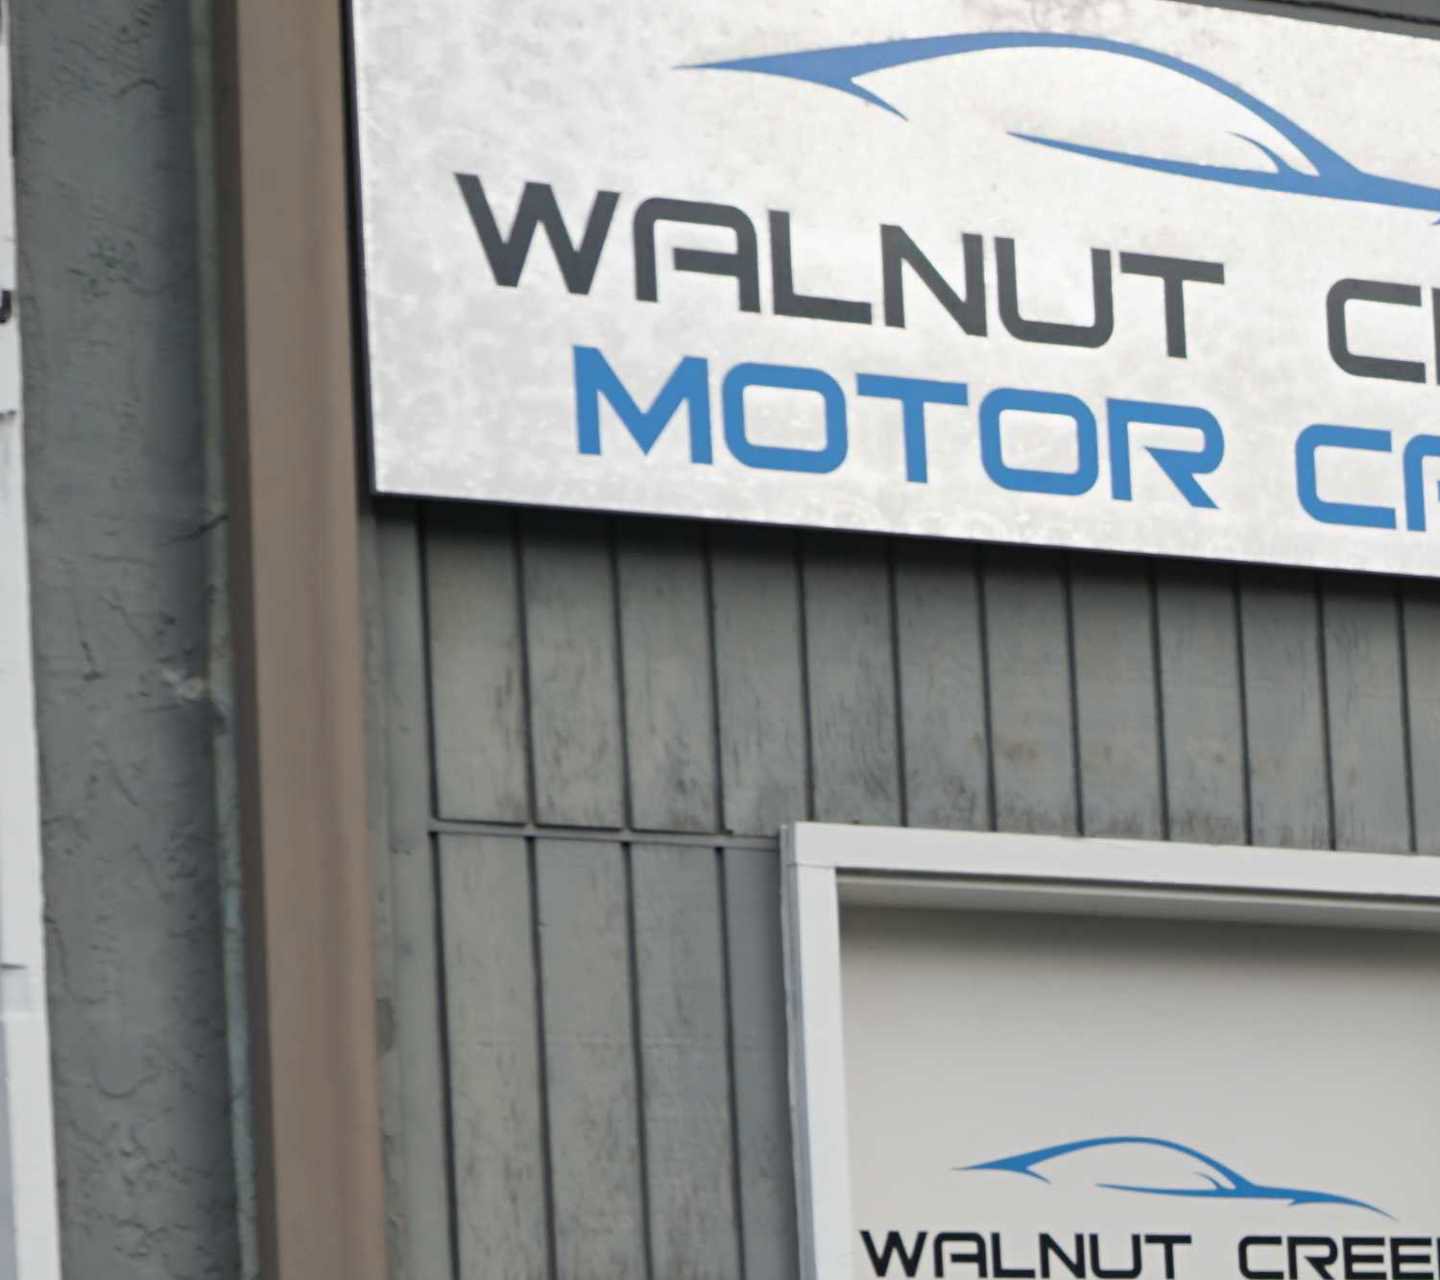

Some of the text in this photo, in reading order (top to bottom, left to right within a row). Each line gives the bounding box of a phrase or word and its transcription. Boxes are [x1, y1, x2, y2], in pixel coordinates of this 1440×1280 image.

[454, 172, 1226, 360] WALNUT
[573, 344, 1226, 509] MOTOR
[859, 1229, 1194, 1280] WALNUT
